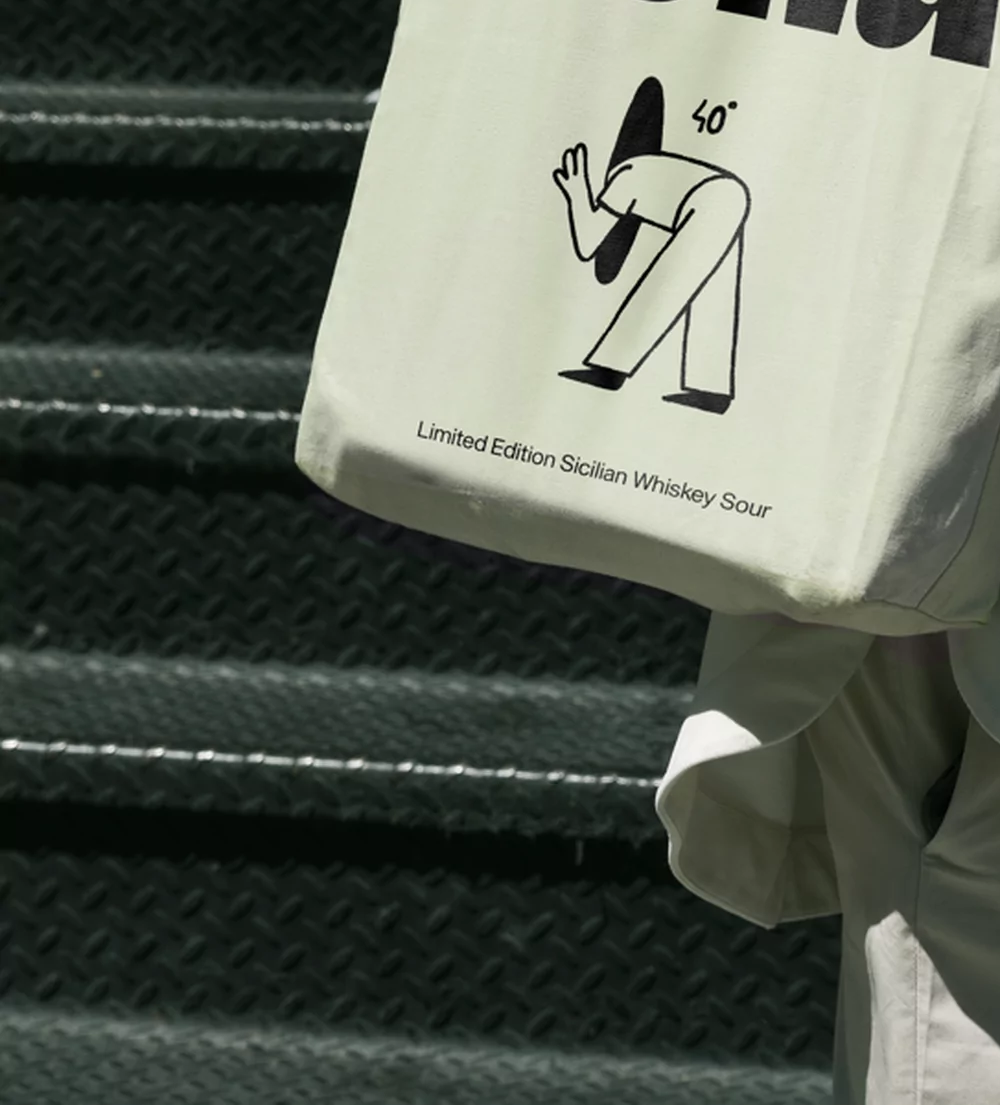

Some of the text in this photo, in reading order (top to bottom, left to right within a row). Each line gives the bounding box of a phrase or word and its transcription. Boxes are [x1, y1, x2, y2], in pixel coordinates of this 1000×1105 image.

[416, 420, 773, 520] Limited Edition Sicilian Whiskey Sour
